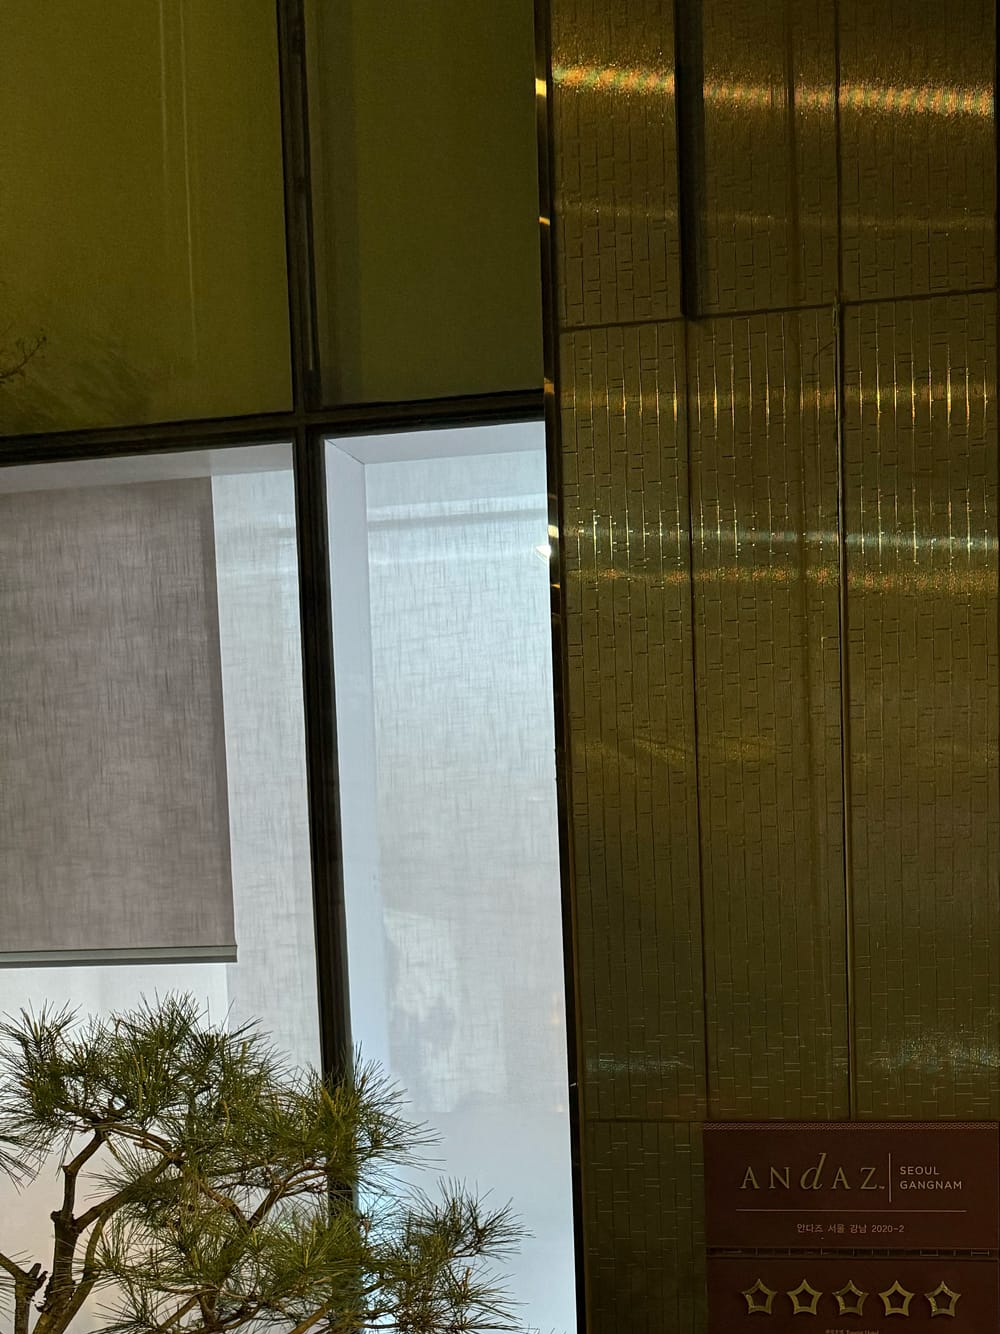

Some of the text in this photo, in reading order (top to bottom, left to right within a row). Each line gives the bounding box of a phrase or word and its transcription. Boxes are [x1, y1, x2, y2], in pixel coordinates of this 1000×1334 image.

[899, 1165, 940, 1176] SEOUL
[899, 1180, 963, 1191] GANGNAM
[796, 1223, 824, 1234] 안다즈
[871, 1224, 905, 1233] 2020-2
